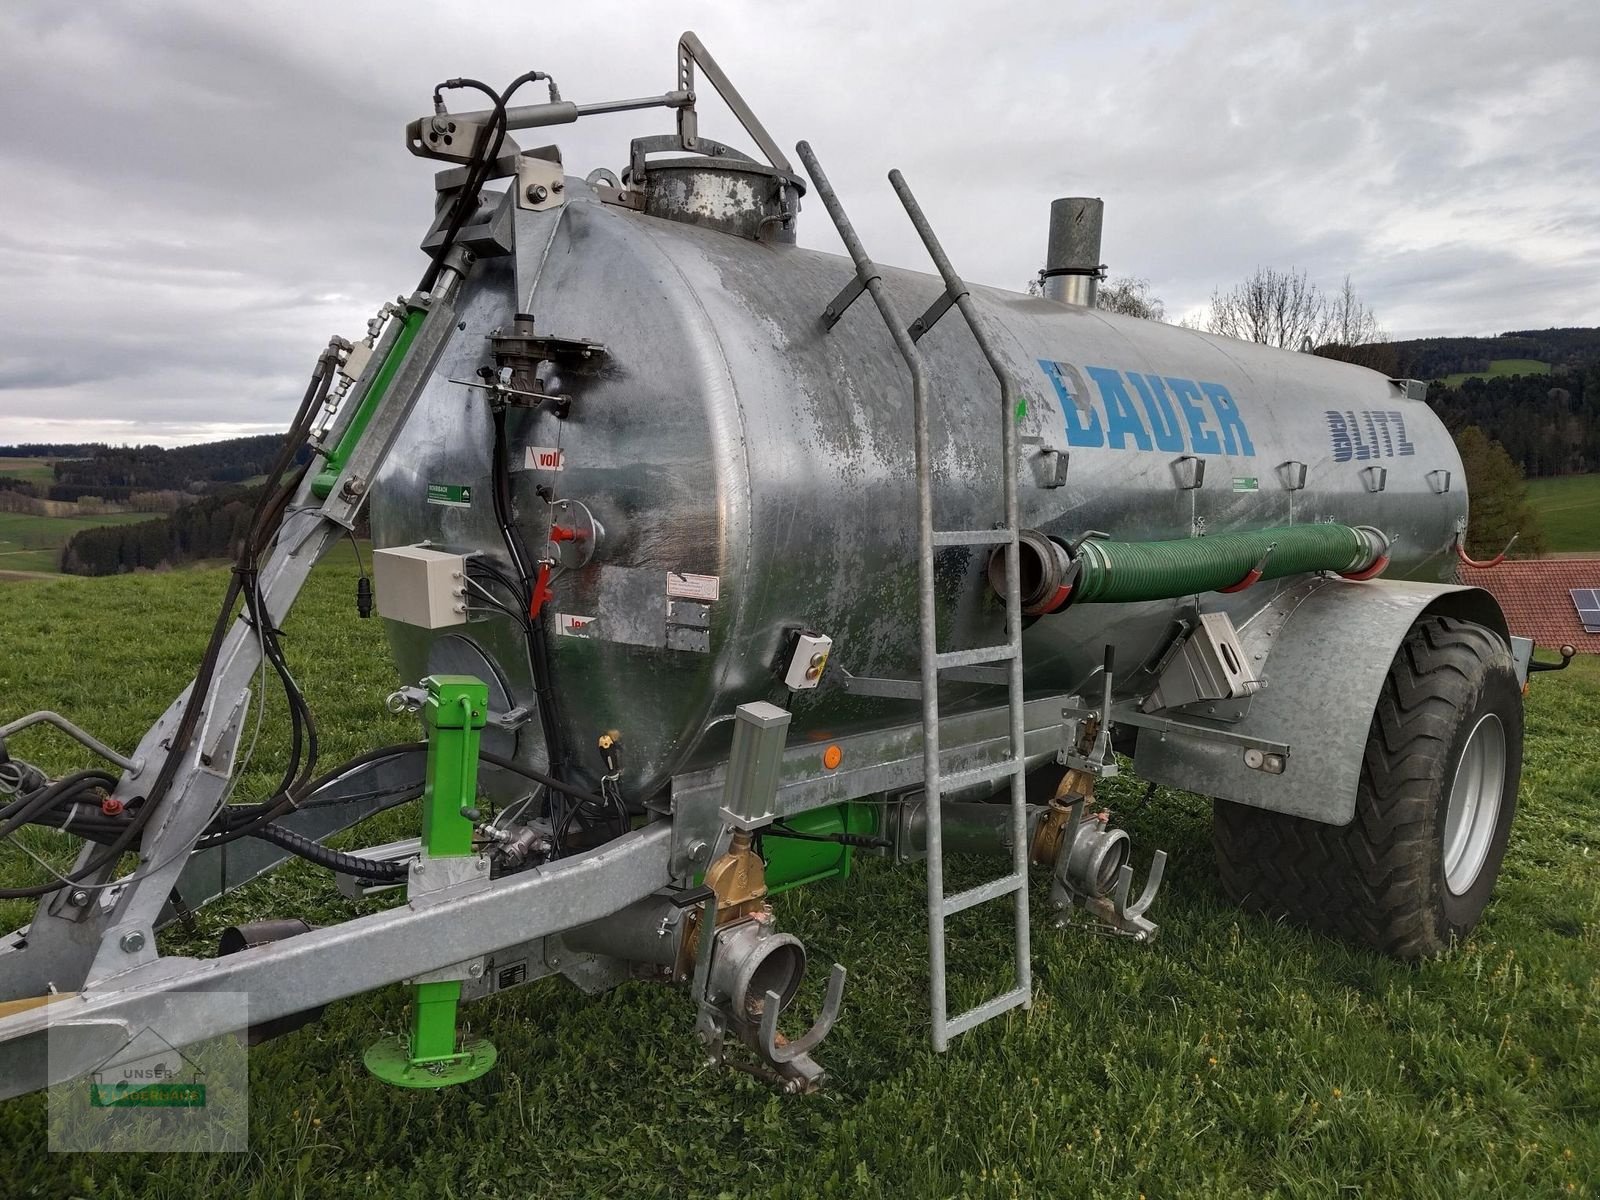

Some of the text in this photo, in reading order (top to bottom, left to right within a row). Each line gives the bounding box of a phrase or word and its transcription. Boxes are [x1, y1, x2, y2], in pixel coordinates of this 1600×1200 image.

[1036, 358, 1256, 457] BAUER
[540, 451, 560, 467] voll
[1323, 410, 1415, 463] BLITZ
